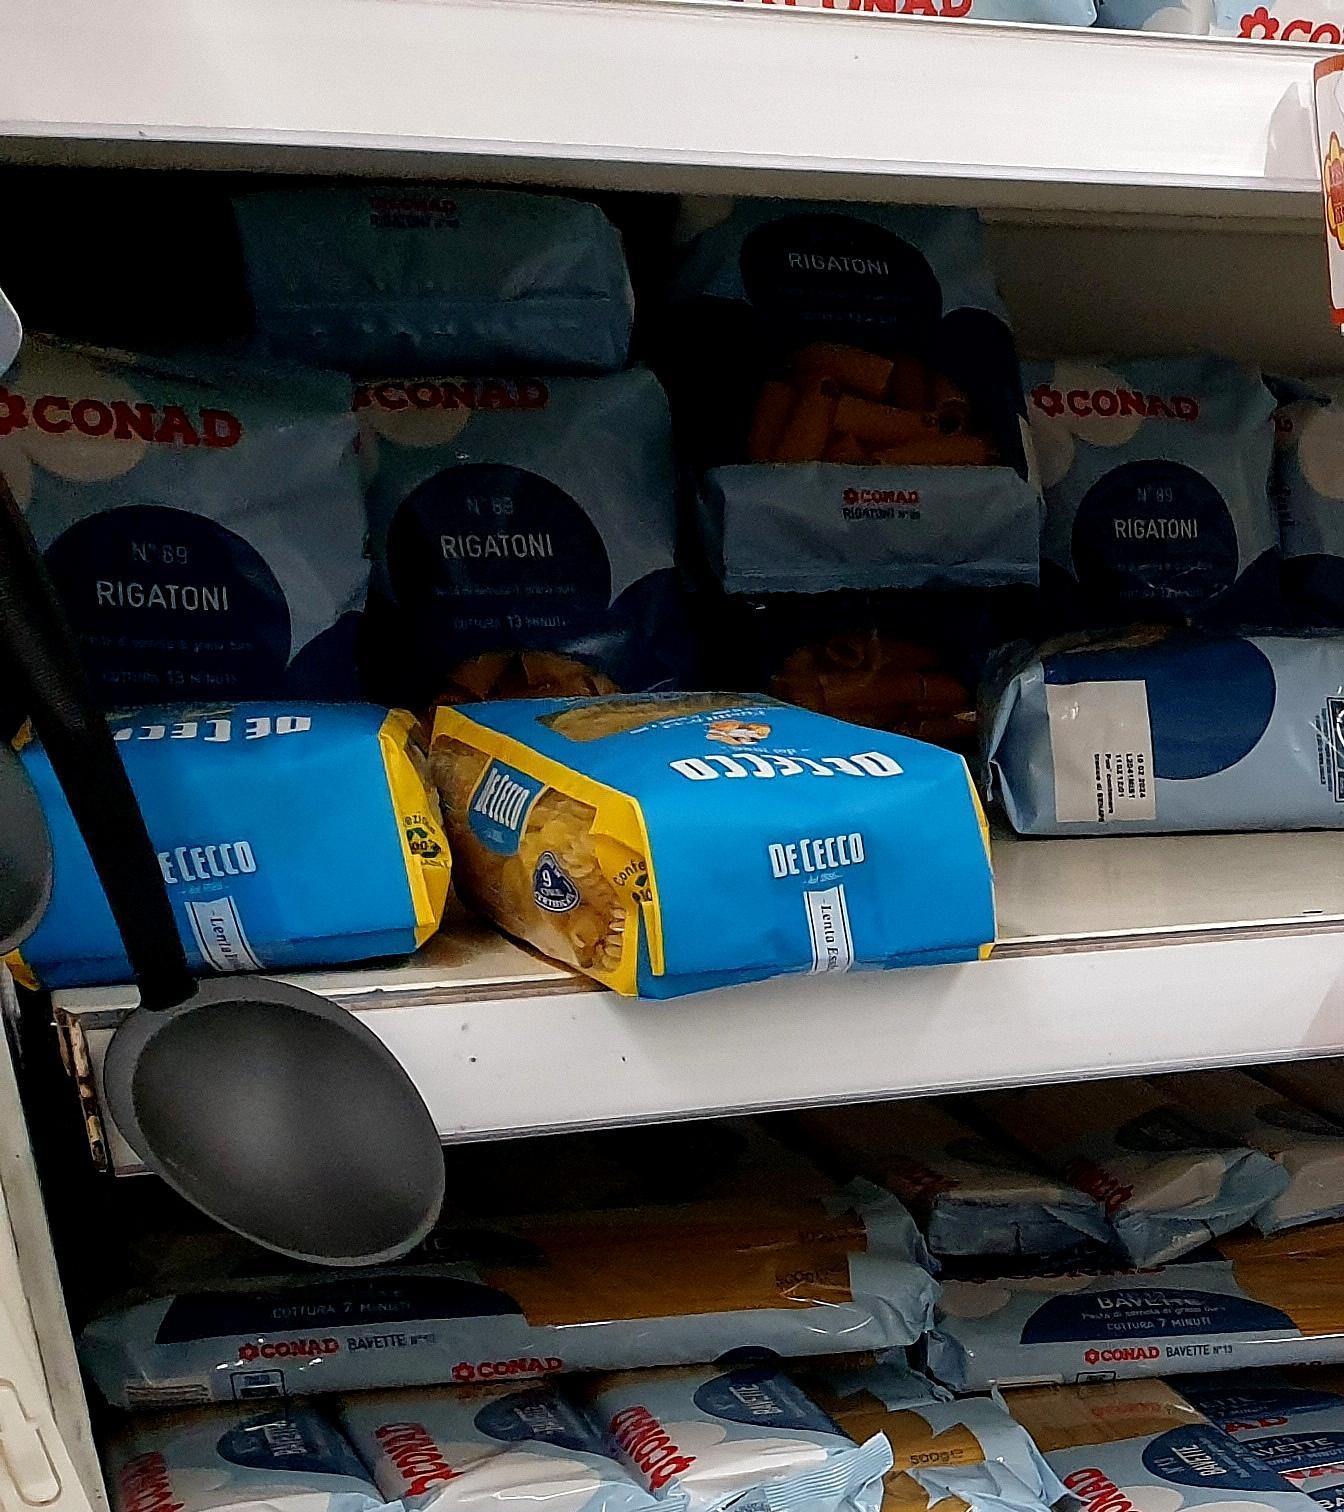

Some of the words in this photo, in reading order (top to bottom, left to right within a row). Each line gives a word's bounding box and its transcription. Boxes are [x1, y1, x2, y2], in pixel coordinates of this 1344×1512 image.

[787, 252, 889, 275] RIGATONI
[1067, 389, 1199, 421] CONAD
[33, 396, 242, 447] CONAD
[1115, 519, 1200, 540] RIGATONI
[440, 533, 555, 560] RIGATONI
[96, 580, 229, 611] RIGATONI
[669, 753, 837, 780] CECCO
[488, 774, 530, 831] CECCO
[175, 842, 257, 882] CECCO
[768, 843, 801, 878] DE
[800, 833, 865, 873] CECCO
[542, 869, 552, 888] 9
[819, 905, 837, 943] Lenta
[261, 1338, 339, 1358] CONAD
[347, 1334, 405, 1351] BAVETTE
[1101, 1347, 1160, 1361] CONAD
[1166, 1344, 1210, 1357] BAVETTE
[477, 1358, 563, 1377] CONAD
[611, 1405, 679, 1474] CONAD
[910, 1448, 949, 1466] 500g
[1171, 1441, 1226, 1477] BAVETTE
